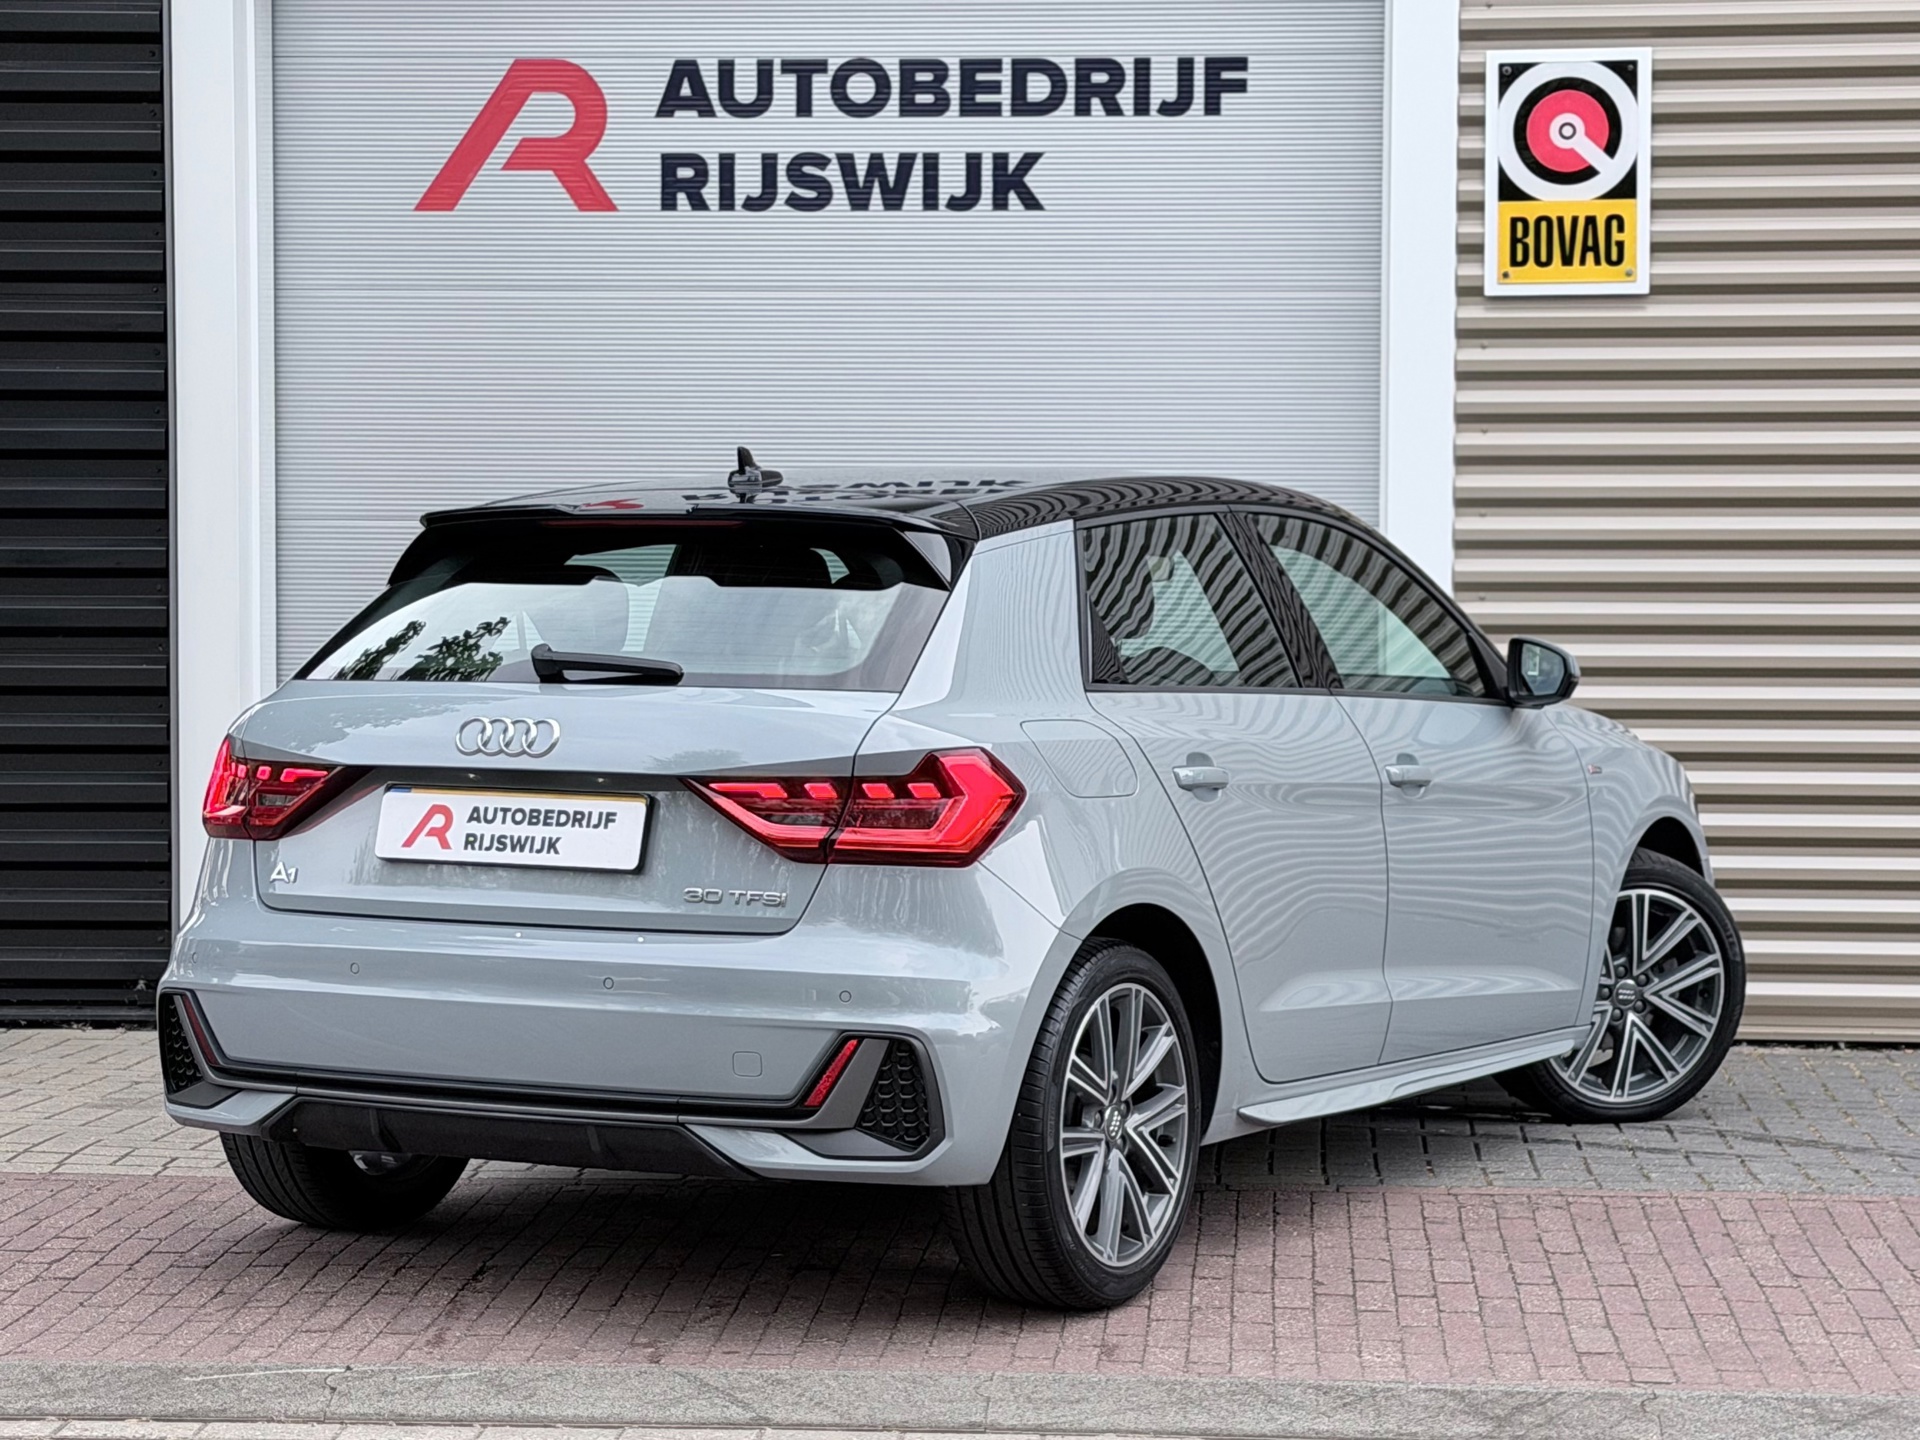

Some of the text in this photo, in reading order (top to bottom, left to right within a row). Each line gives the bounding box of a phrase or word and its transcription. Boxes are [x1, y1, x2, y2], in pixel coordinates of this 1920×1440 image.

[655, 56, 1249, 118] AUTOBEDRIJF
[660, 151, 1047, 212] RIJSWIJK
[1509, 213, 1626, 268] BOVAG
[466, 805, 618, 830] AUTOBEDRIJF
[463, 832, 562, 855] RIJSWIJK
[269, 861, 298, 884] A1
[683, 886, 723, 904] 30
